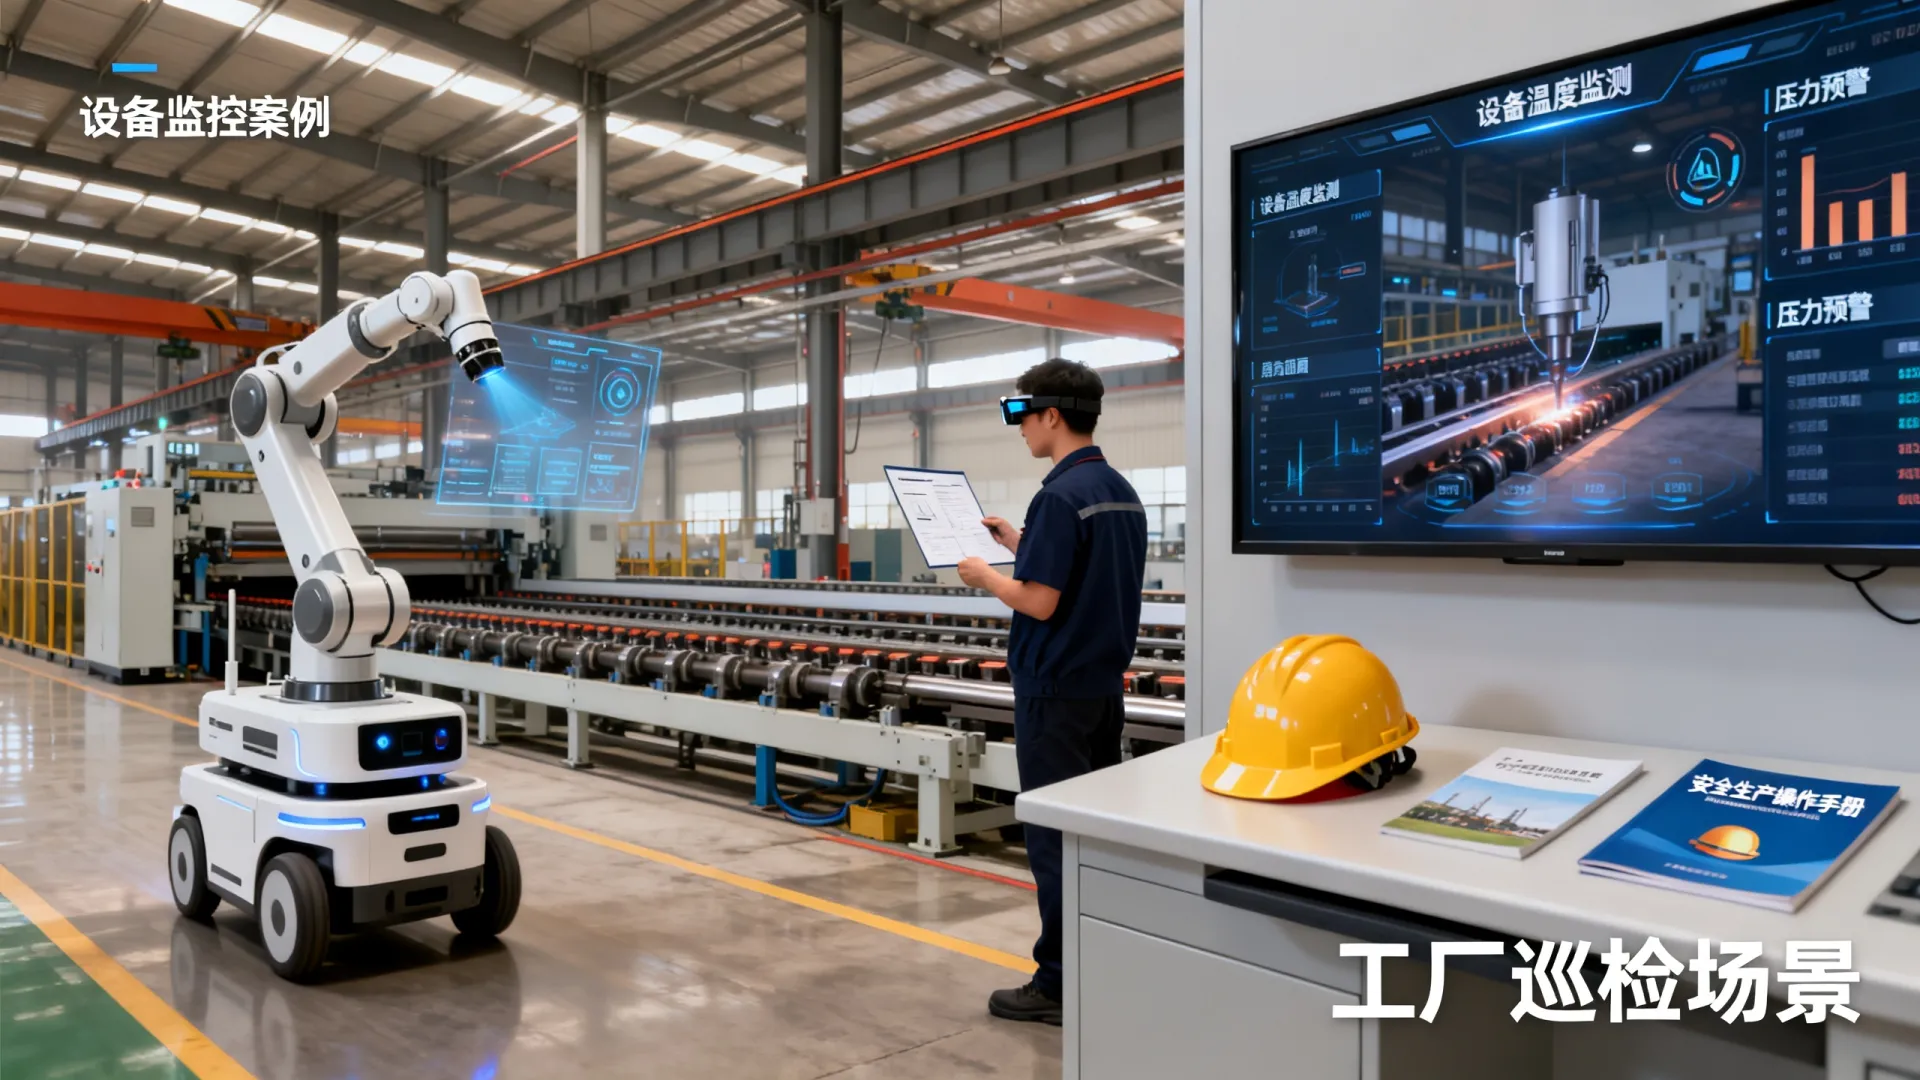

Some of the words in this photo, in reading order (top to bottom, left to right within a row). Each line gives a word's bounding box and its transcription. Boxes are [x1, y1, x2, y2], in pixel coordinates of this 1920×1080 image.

[1476, 62, 1632, 127] 设备温度监测
[1774, 66, 1871, 113] 压力预警
[1777, 291, 1874, 328] 压力预警
[1688, 774, 1865, 818] 安全生产操作手册
